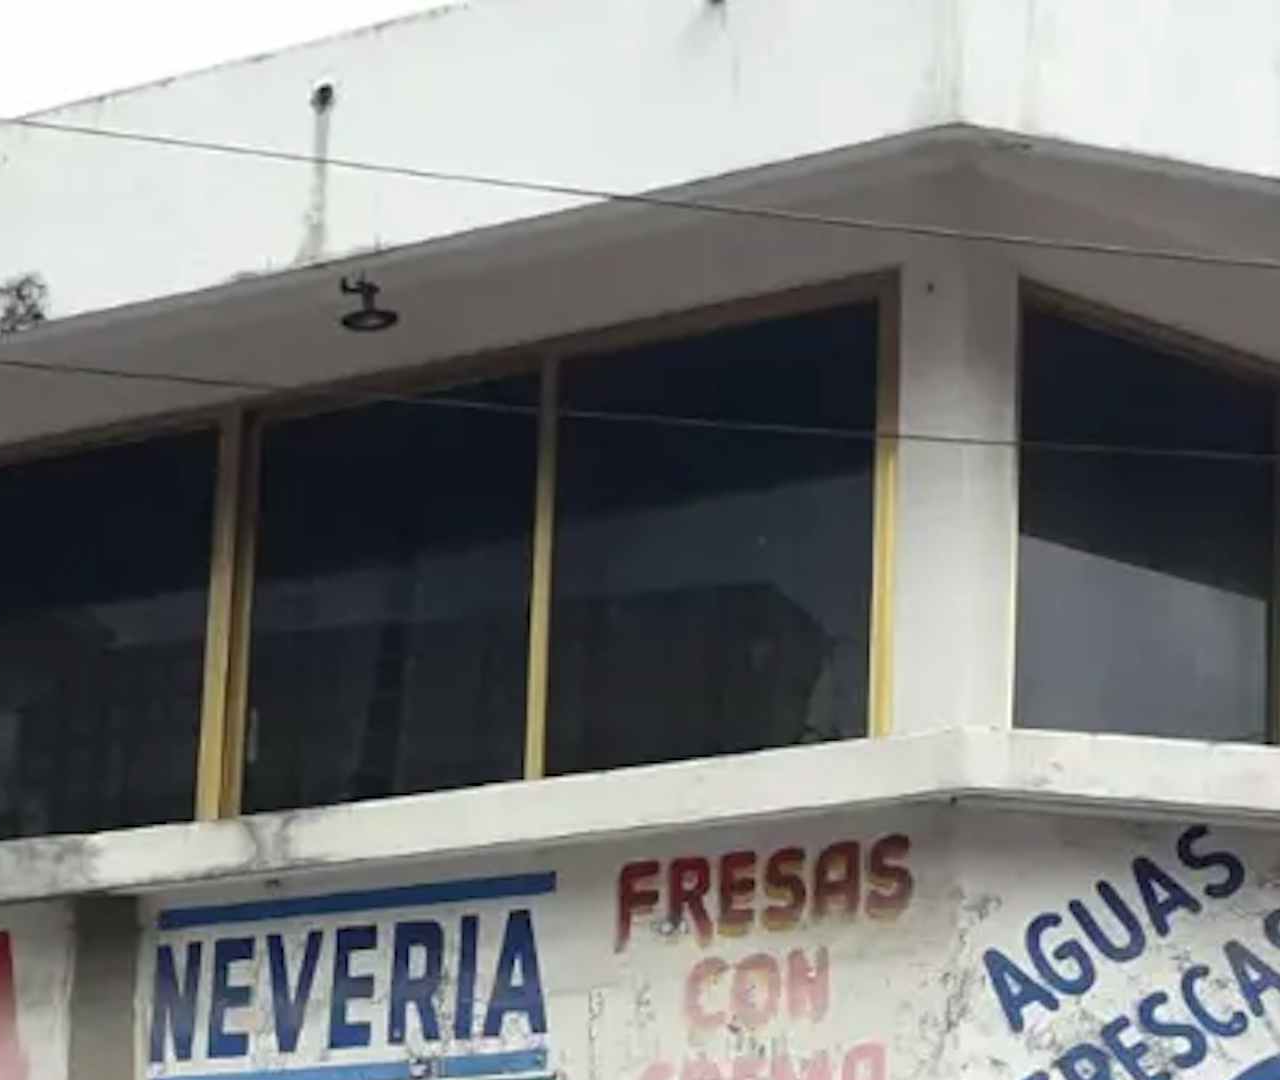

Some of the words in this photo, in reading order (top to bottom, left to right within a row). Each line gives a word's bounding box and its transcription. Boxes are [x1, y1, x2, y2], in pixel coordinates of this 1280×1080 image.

[614, 833, 915, 954] FRESAS
[983, 824, 1246, 1034] AGUAS
[149, 909, 548, 1063] NEVERIA
[683, 945, 831, 1033] CON
